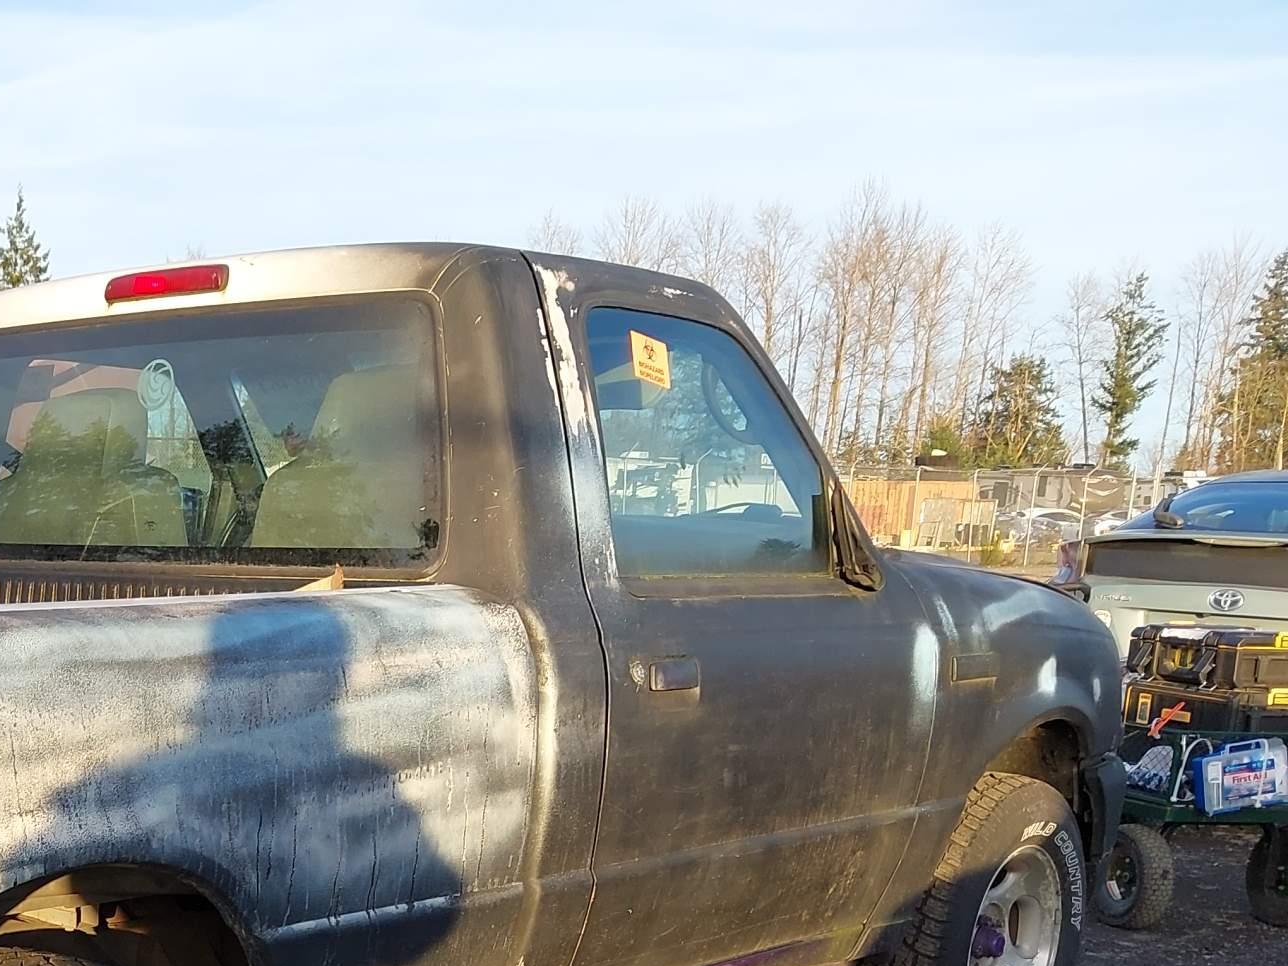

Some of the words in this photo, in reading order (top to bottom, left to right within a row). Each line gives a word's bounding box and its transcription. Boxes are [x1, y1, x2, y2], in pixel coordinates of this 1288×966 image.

[1232, 775, 1252, 784] First
[1020, 821, 1058, 842] WILD
[1053, 830, 1083, 932] COUNTRY
